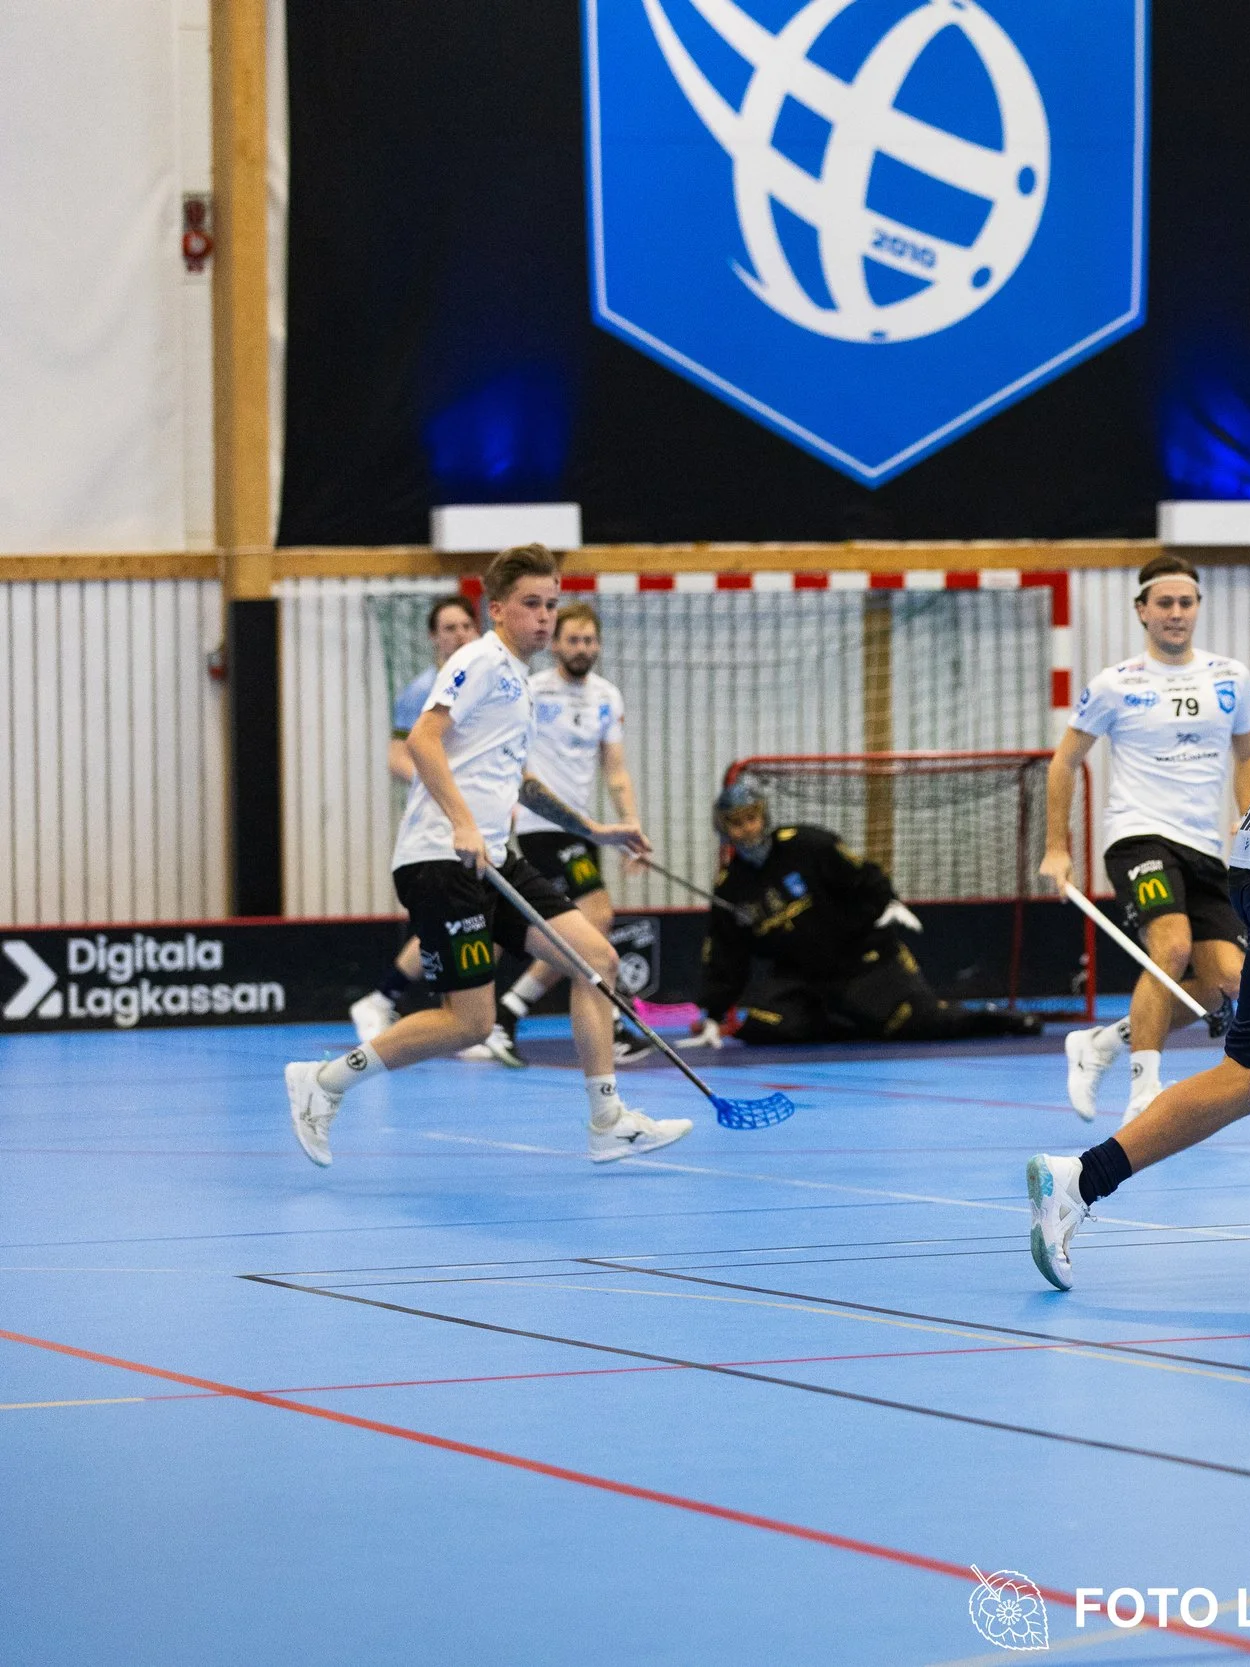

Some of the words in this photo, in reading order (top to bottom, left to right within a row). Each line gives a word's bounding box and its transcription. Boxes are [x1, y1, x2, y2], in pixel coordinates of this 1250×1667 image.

[871, 227, 938, 269] 2010
[1171, 697, 1200, 717] 79
[67, 932, 224, 984] Digitala
[67, 977, 287, 1029] Lagkassan
